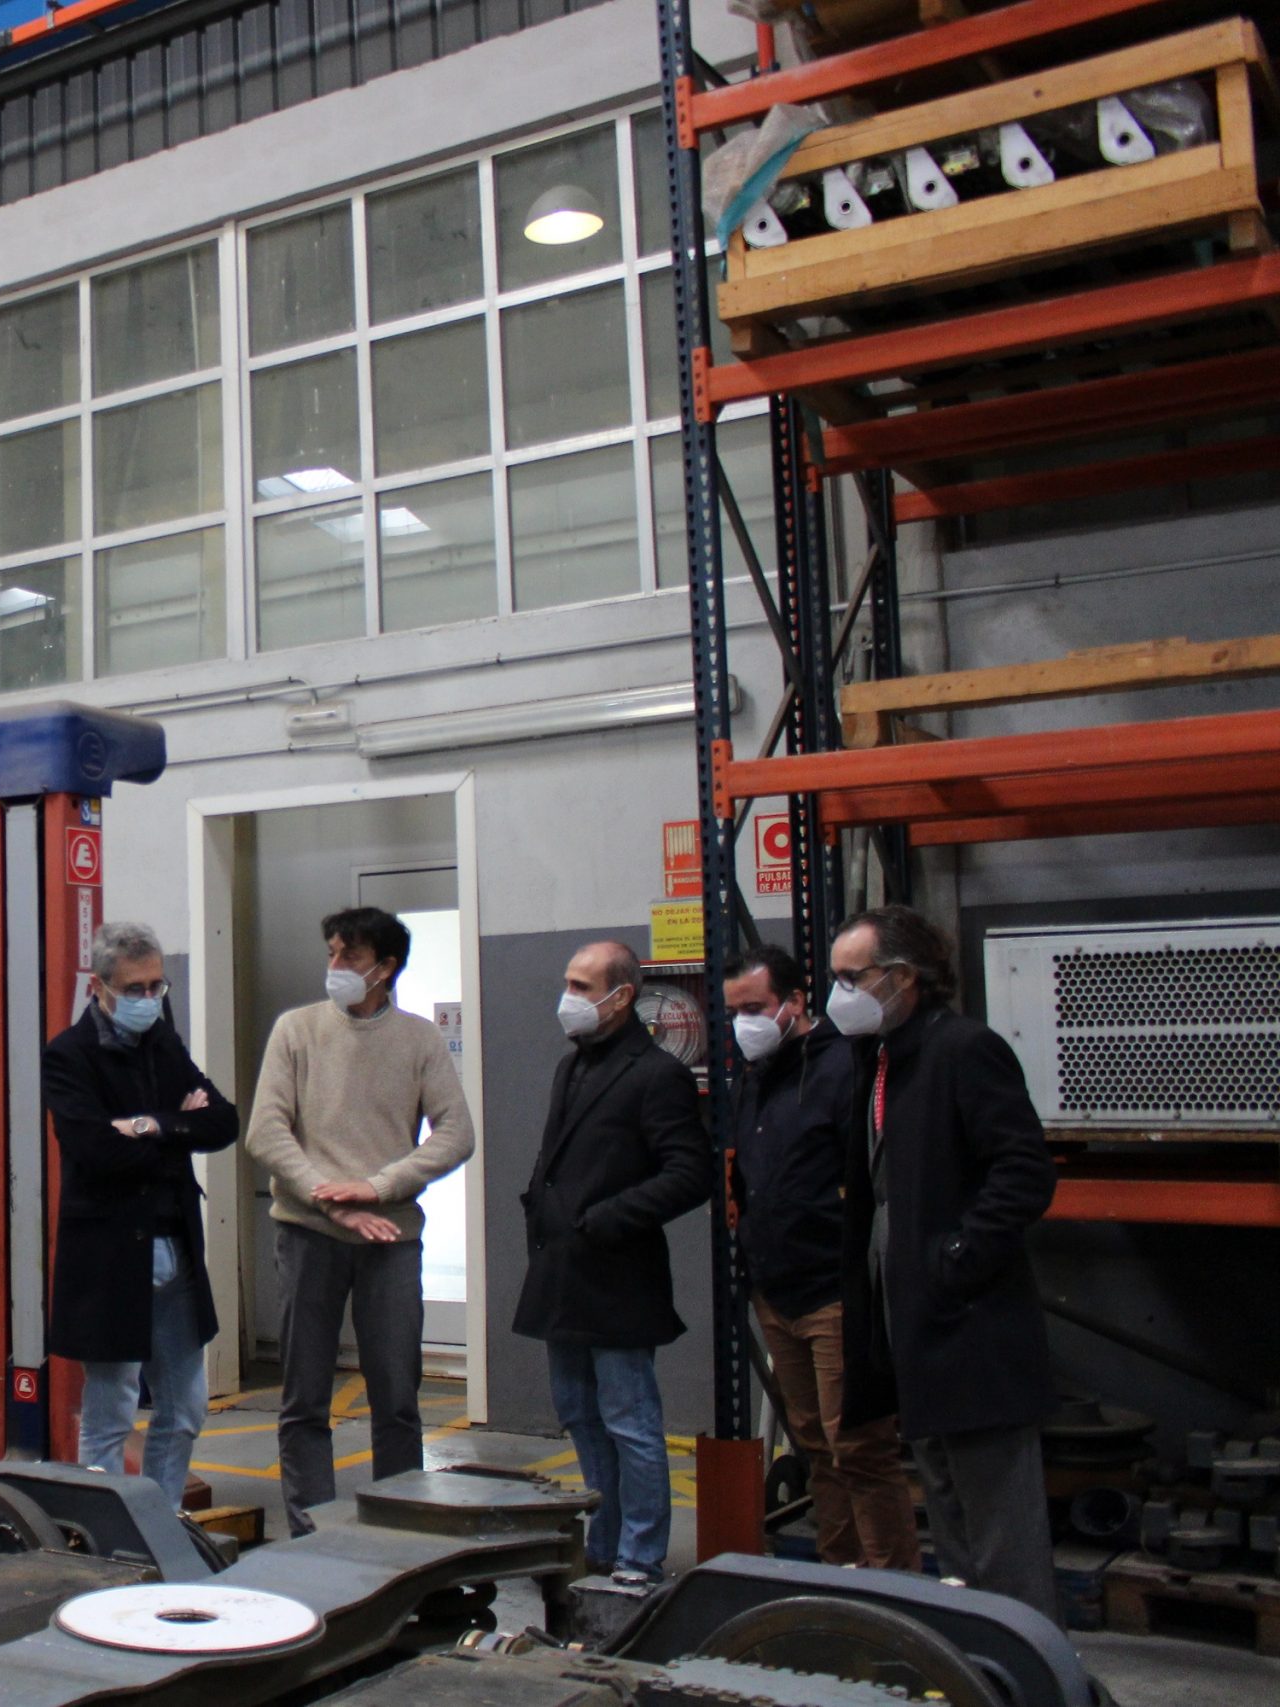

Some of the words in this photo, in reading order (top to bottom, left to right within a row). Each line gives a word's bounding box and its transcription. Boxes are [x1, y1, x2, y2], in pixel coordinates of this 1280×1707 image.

[75, 843, 93, 868] E
[759, 882, 771, 893] DE
[19, 1377, 32, 1392] E
